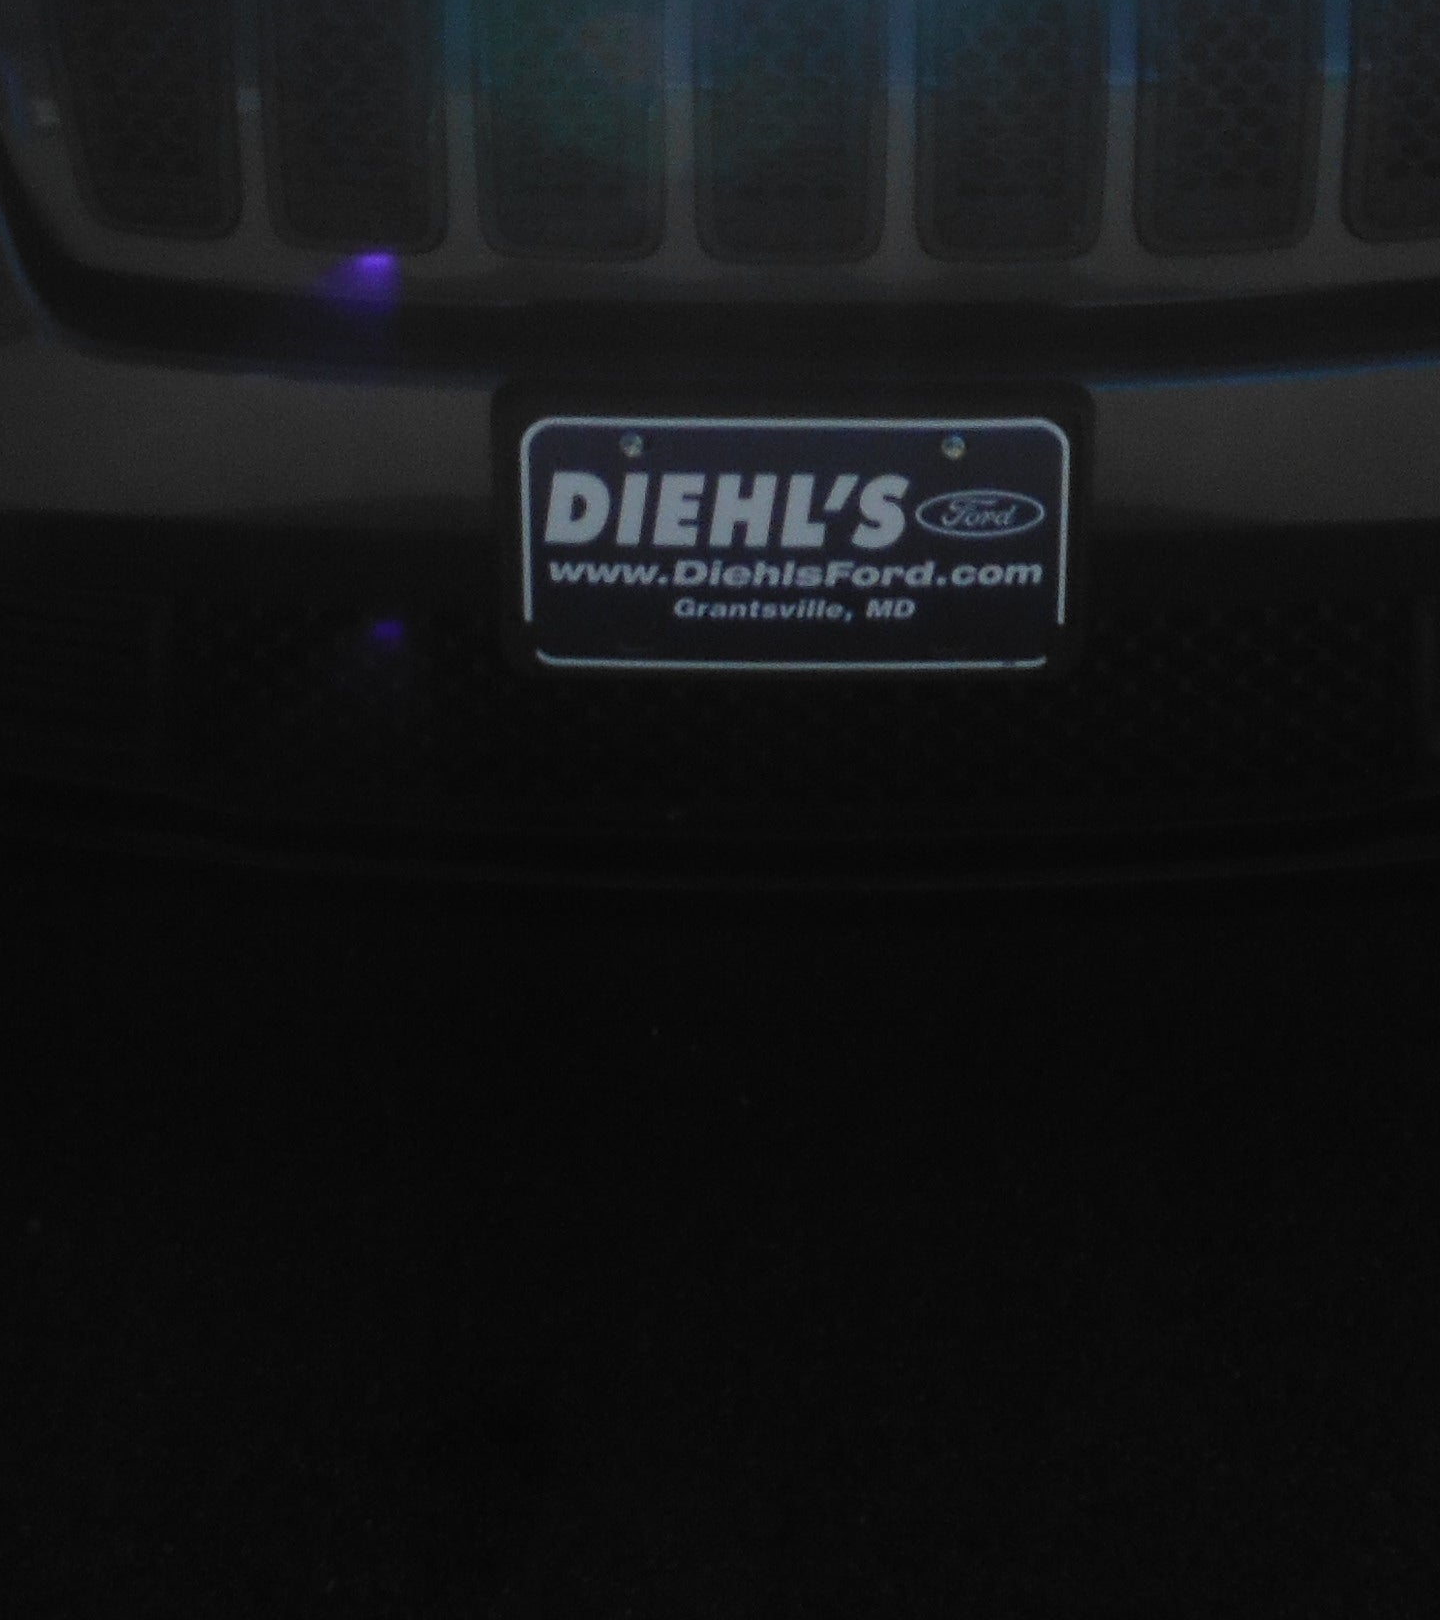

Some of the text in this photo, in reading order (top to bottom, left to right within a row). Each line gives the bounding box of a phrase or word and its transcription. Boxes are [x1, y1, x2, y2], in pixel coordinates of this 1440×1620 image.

[544, 470, 909, 548] DIEHL'S
[943, 495, 1016, 528] Ford
[549, 559, 1043, 587] www.DiehlsFord.com
[673, 597, 916, 622] Grantsville, MD
